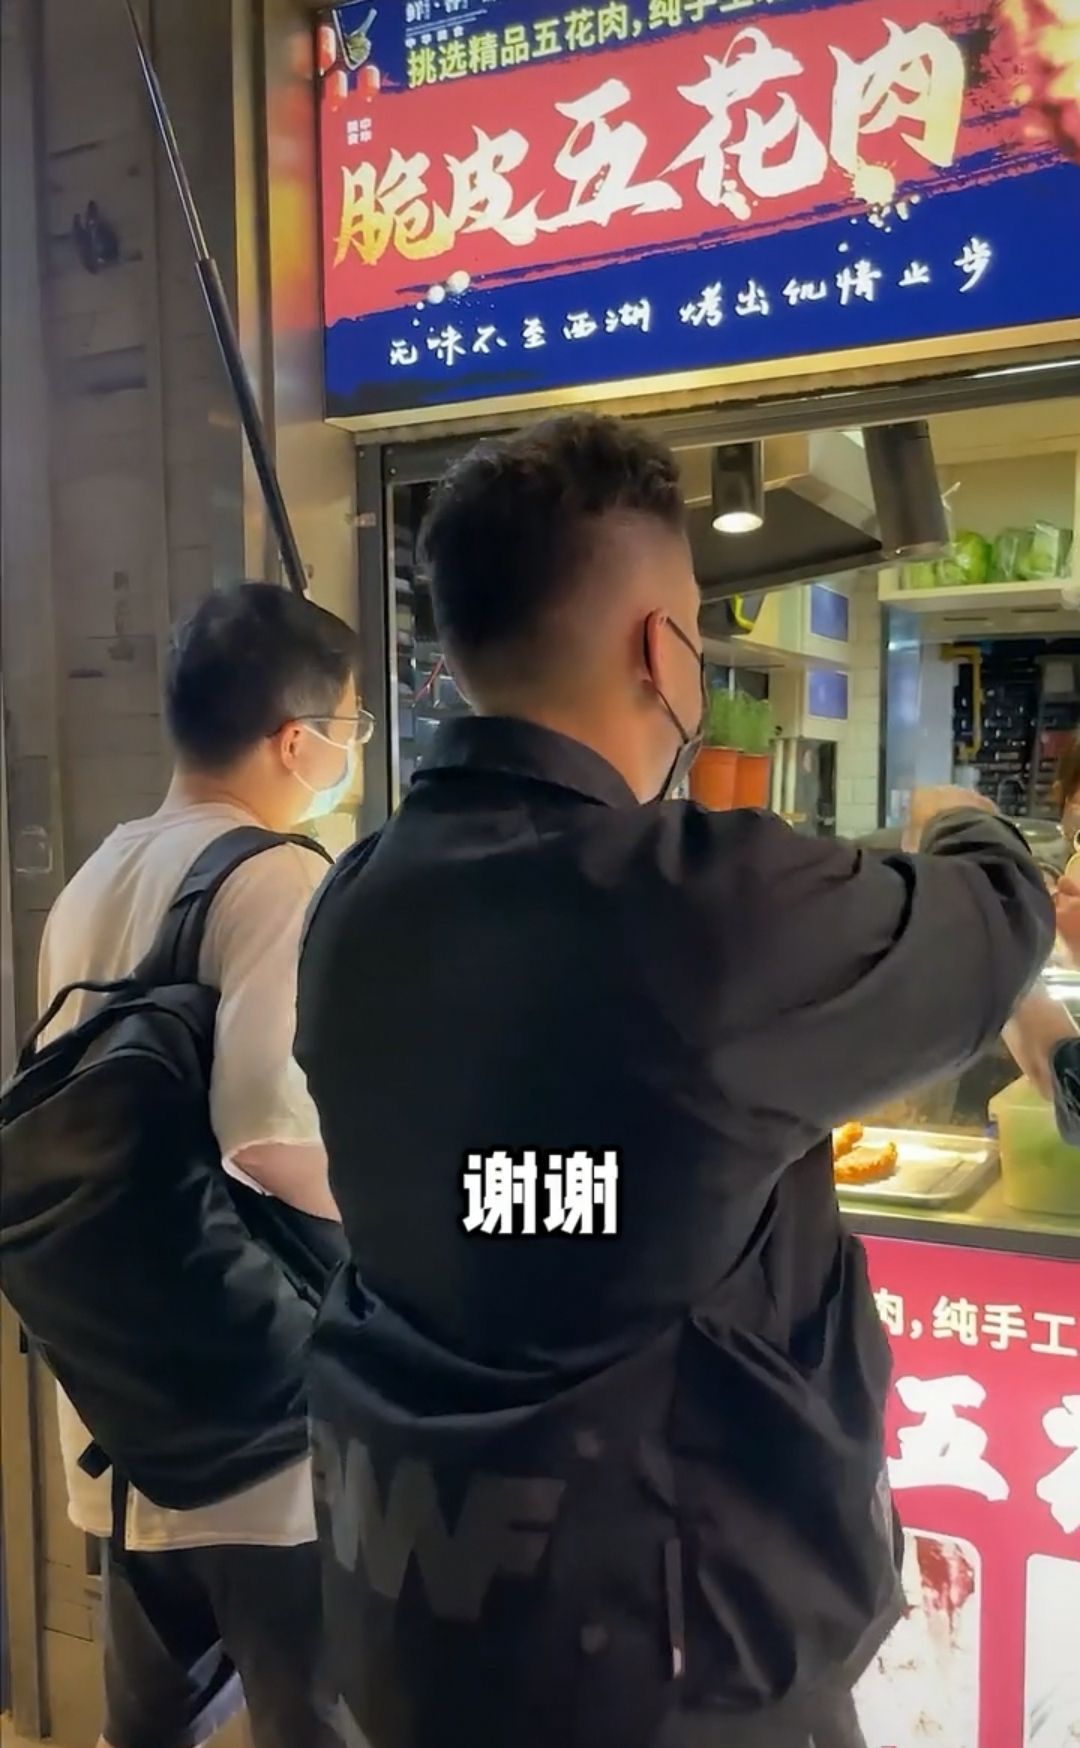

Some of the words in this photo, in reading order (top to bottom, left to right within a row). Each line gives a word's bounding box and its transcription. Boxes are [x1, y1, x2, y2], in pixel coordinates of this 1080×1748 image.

[333, 18, 965, 268] 脆皮五花肉
